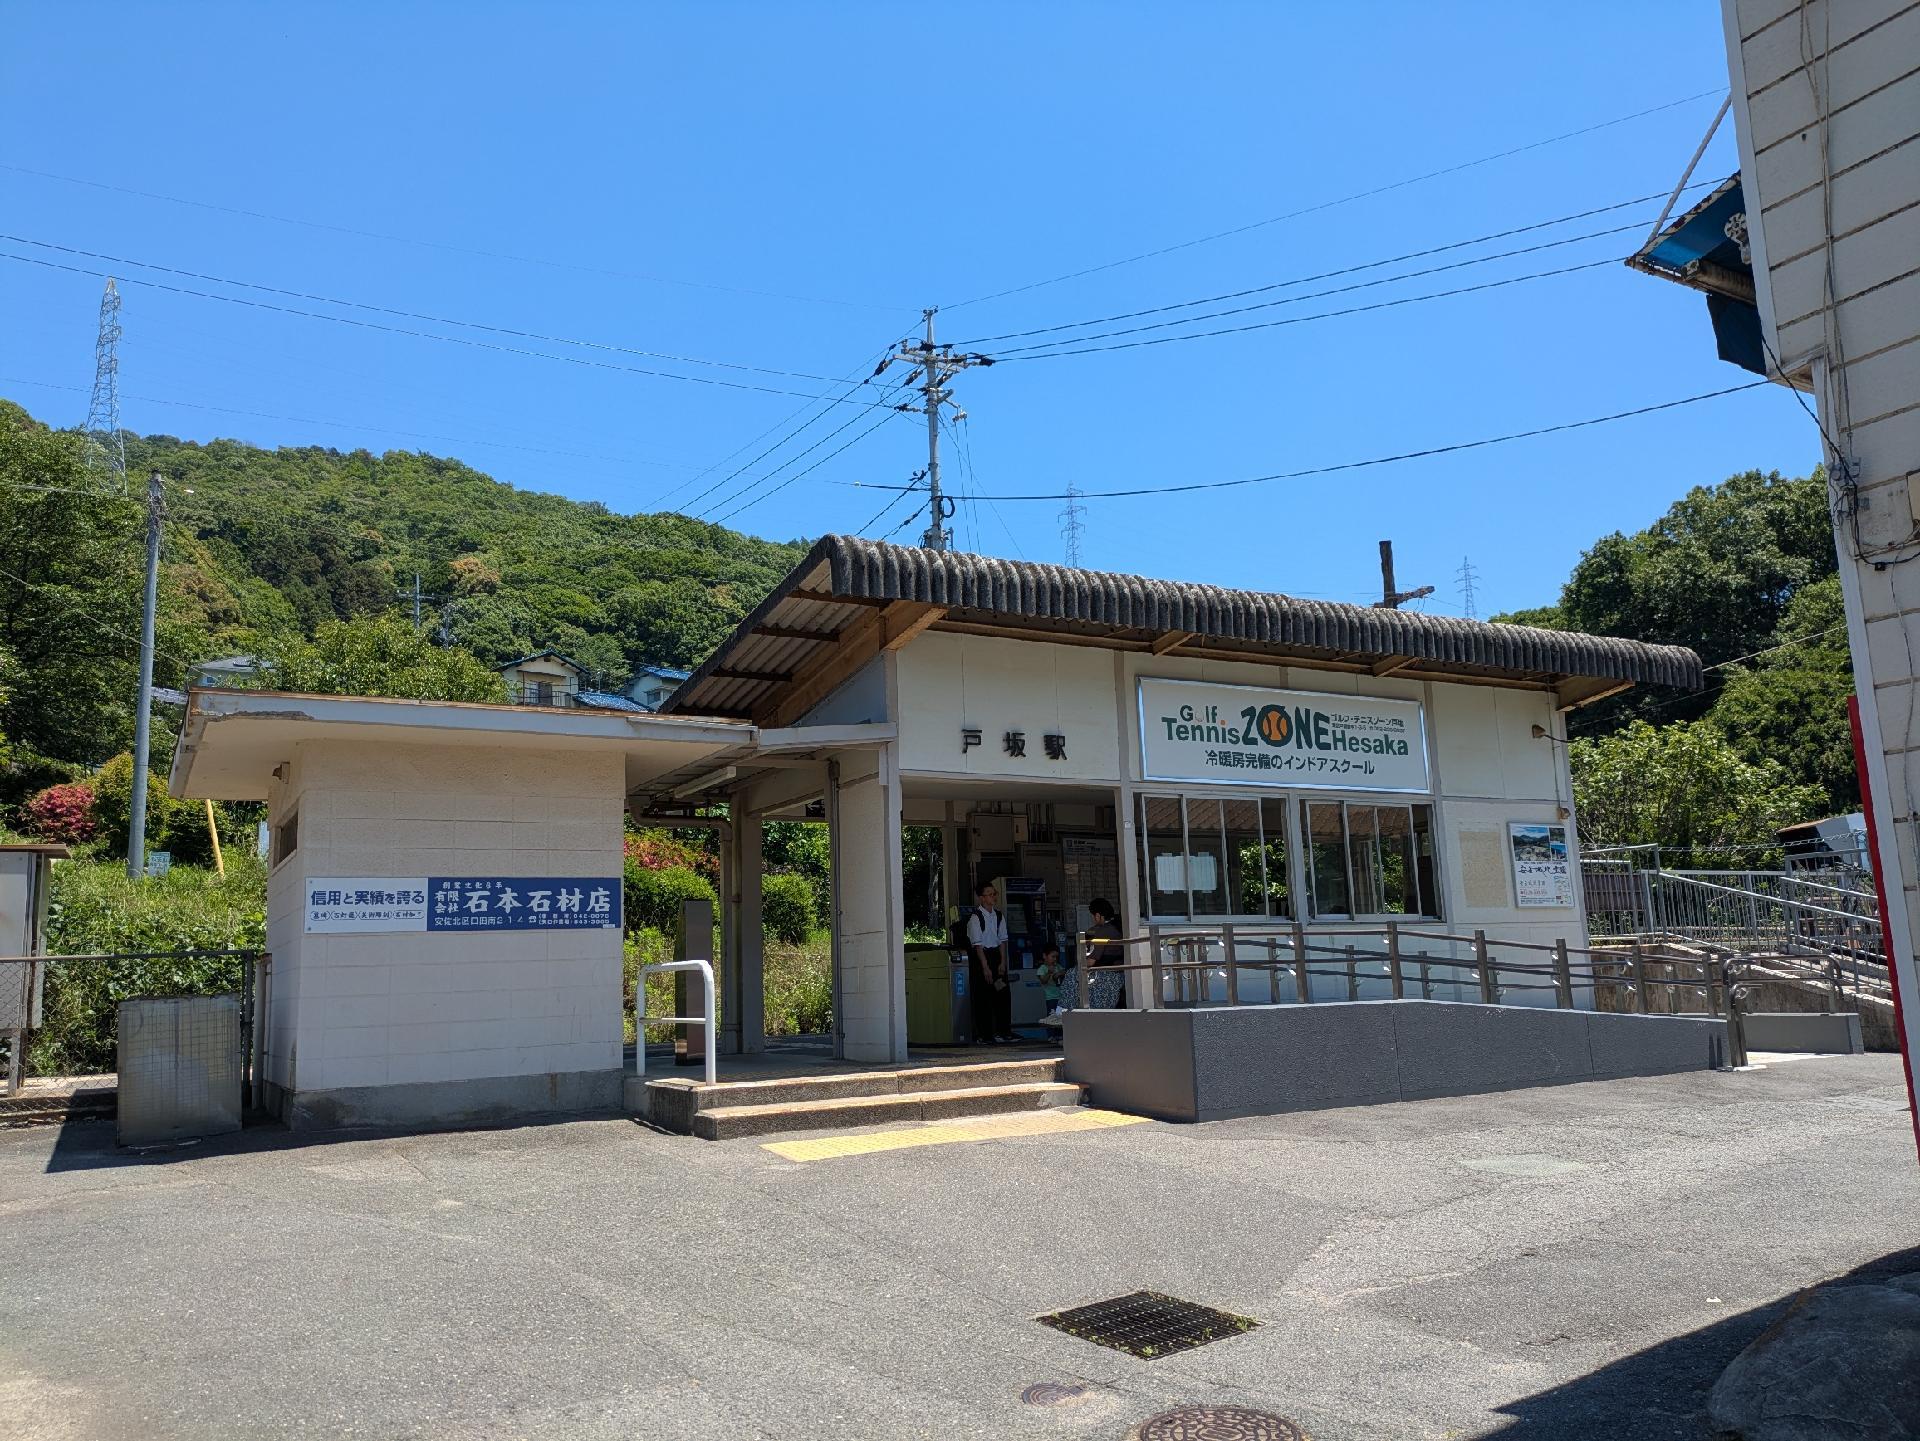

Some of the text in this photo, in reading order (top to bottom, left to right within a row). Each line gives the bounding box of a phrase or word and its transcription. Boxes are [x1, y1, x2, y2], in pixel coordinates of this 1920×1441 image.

[1179, 705, 1218, 723] Golf
[1161, 704, 1409, 756] Tennis ZONE Hesaka
[961, 729, 1068, 760] 戸坂駅
[1205, 750, 1376, 775] 冷暖房完備のインドアスクール
[310, 890, 425, 906] 信用と実績を誇る
[462, 887, 611, 914] 石本石材店
